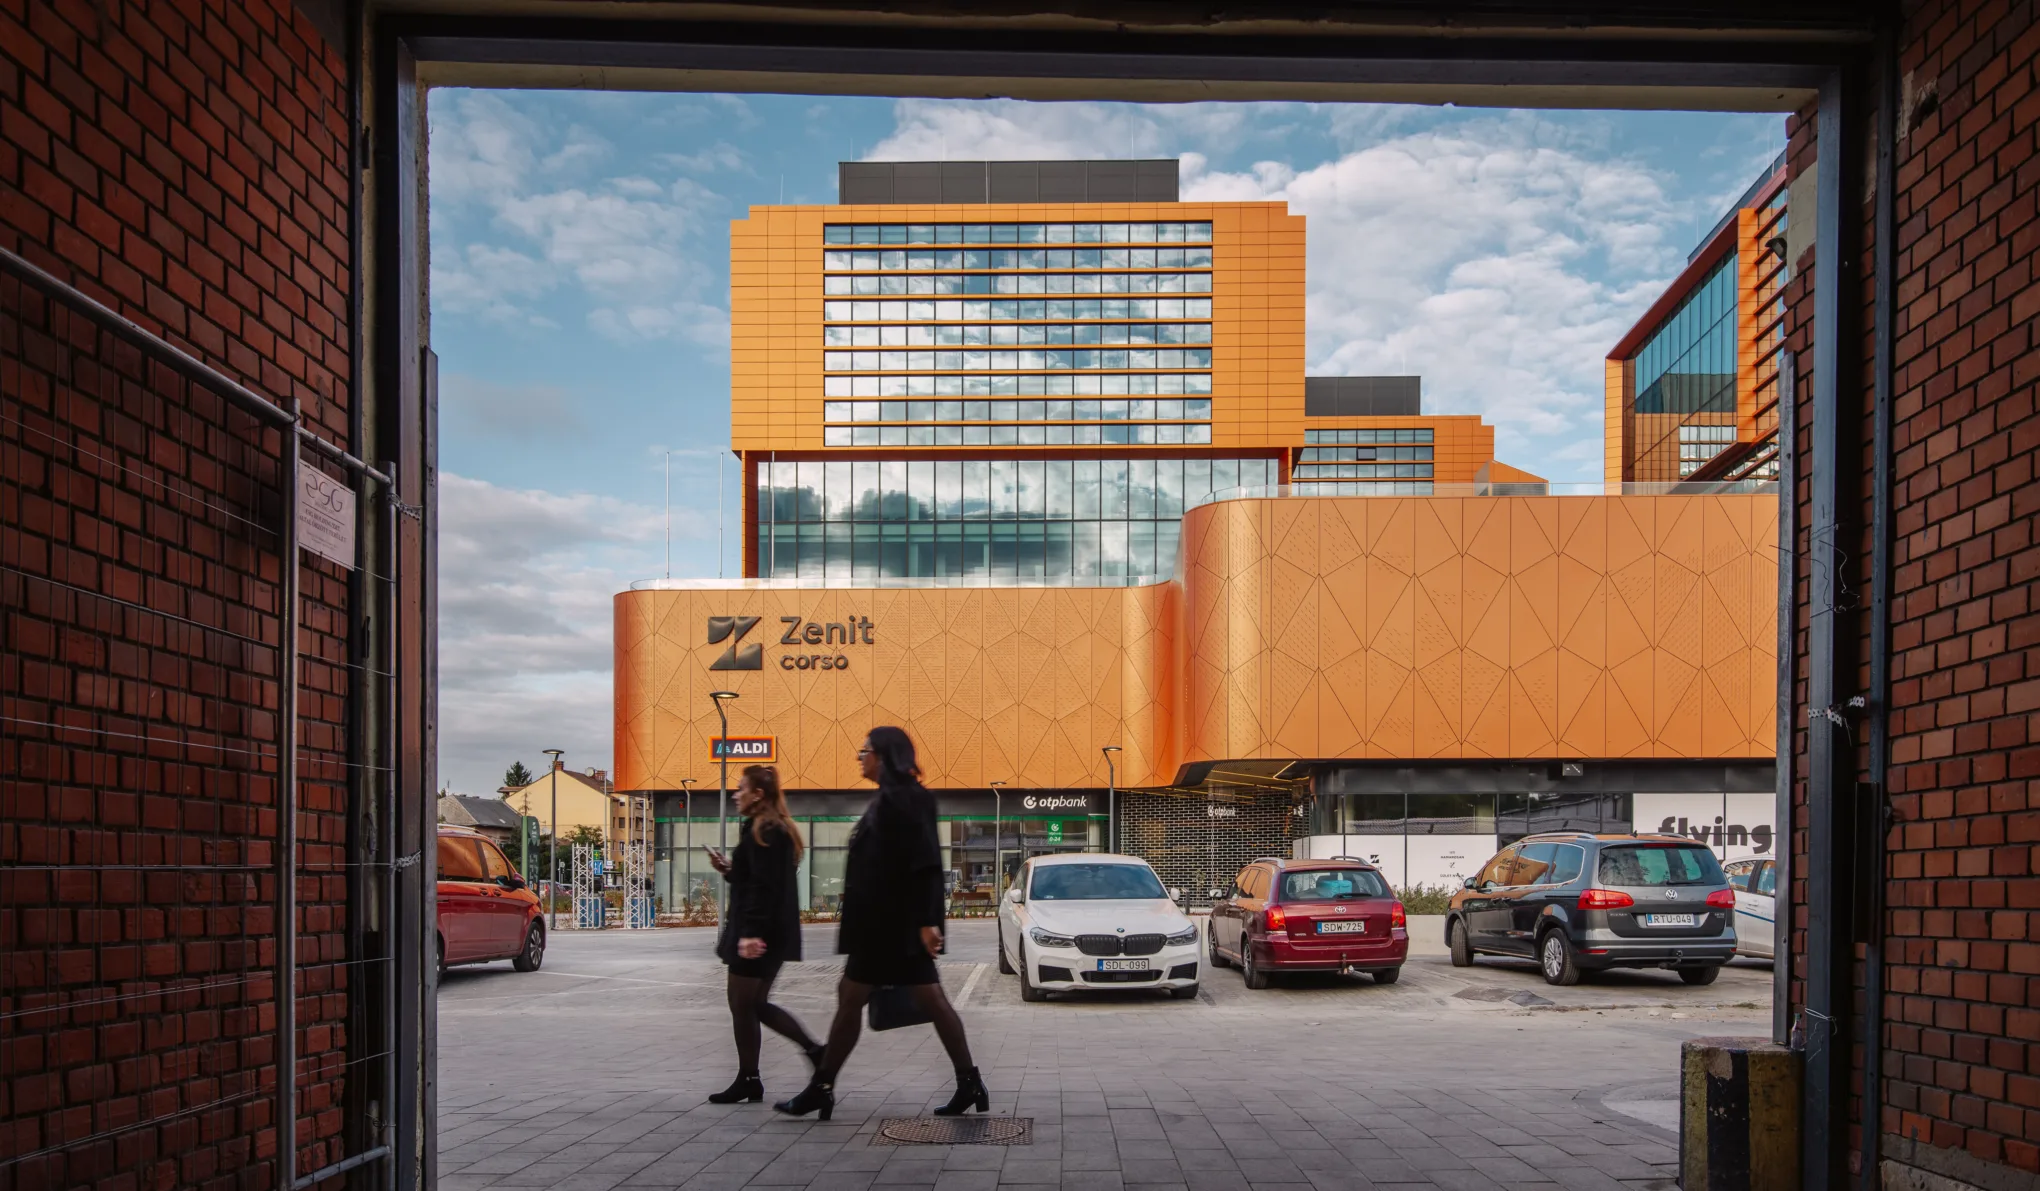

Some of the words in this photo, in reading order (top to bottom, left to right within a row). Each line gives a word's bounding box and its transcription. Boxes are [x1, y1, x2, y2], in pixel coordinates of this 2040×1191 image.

[780, 615, 874, 645] Zenit
[780, 654, 849, 670] corso
[732, 742, 768, 755] ALDI
[1039, 795, 1088, 810] otpbank
[1658, 816, 1772, 854] flying
[1653, 914, 1692, 924] RTU-049
[1323, 922, 1363, 932] SDW-725
[1105, 960, 1146, 970] SDL-099
